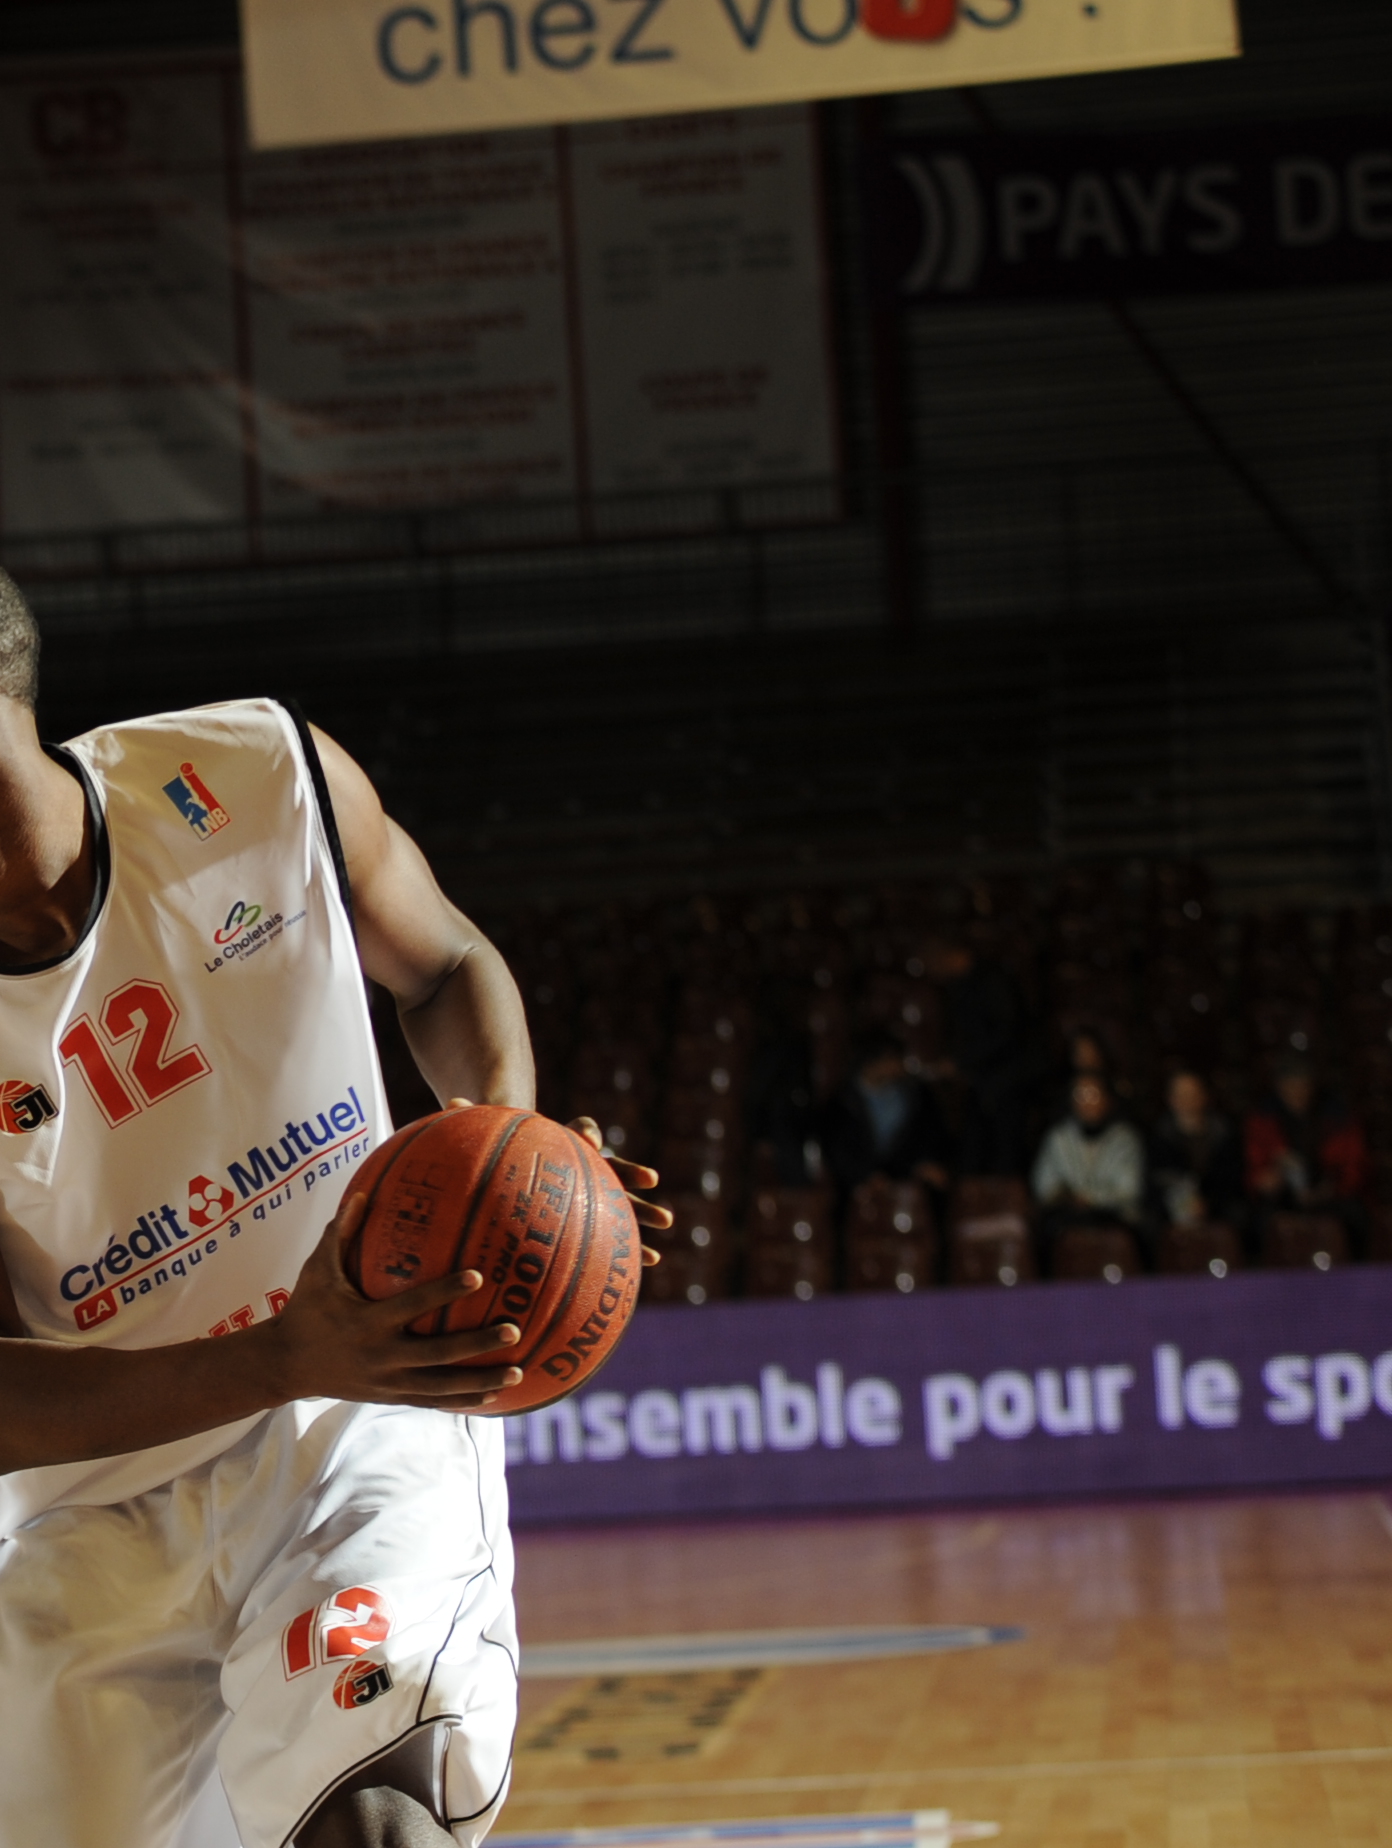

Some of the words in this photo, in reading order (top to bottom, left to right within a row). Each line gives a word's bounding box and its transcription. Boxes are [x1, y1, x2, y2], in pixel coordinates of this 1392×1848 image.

[376, 0, 675, 84] chez
[996, 160, 1246, 265] PAYS
[1271, 148, 1392, 250] DE
[192, 806, 230, 840] LNB
[204, 954, 224, 974] Le
[222, 911, 284, 960] Choletais
[58, 978, 213, 1130] 12
[59, 1203, 190, 1301] Crédit
[226, 1086, 367, 1200] Mutuel
[81, 1298, 112, 1324] LA
[119, 1238, 218, 1306] banque
[228, 1219, 242, 1239] à
[251, 1183, 293, 1222] qui
[303, 1136, 371, 1192] parler
[921, 1366, 1136, 1462] pour
[1152, 1342, 1242, 1431] le
[280, 1584, 397, 1682] 12
